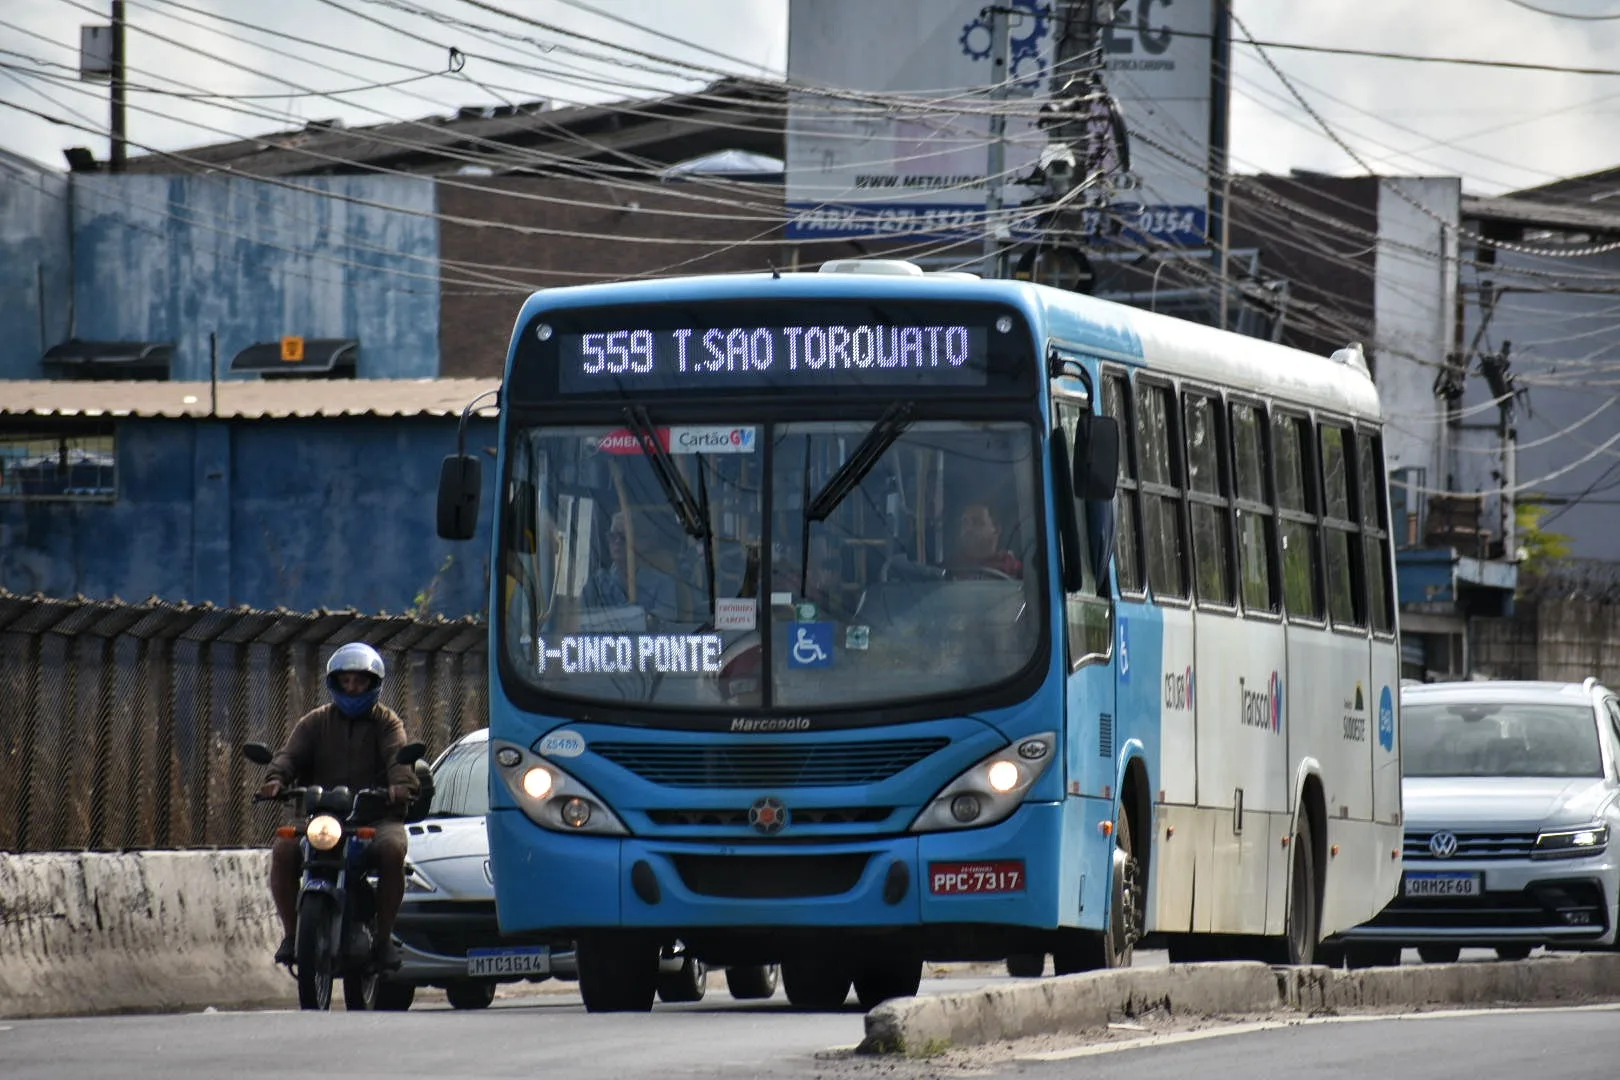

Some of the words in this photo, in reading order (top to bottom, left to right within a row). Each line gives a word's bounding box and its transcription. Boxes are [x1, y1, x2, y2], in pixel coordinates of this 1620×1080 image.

[583, 330, 652, 373] 559
[783, 325, 968, 369] TORQUATO
[730, 717, 811, 731] Marcopolo
[1239, 677, 1270, 729] Transcol
